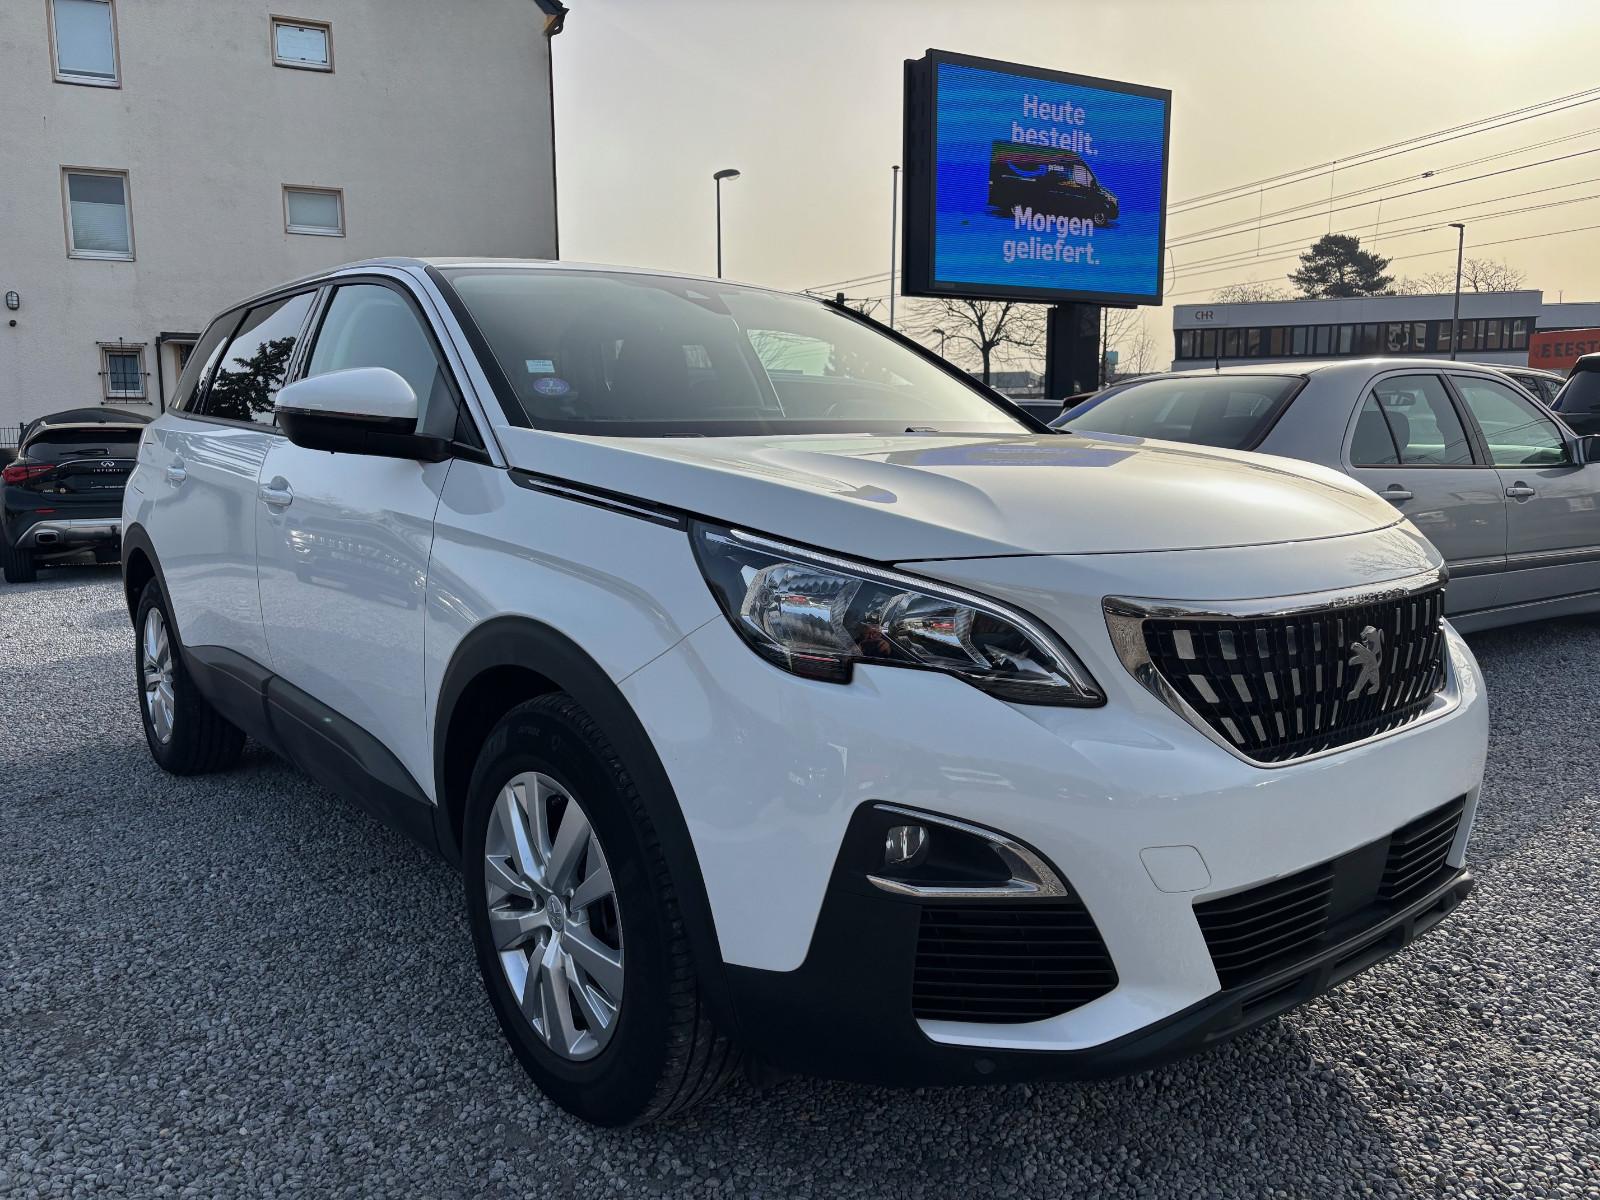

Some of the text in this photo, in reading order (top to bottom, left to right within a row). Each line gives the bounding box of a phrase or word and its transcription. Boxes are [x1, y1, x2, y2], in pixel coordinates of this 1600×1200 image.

[1023, 93, 1086, 125] Heute
[1011, 120, 1098, 156] bestellt.
[1014, 205, 1094, 238] Morgen
[1003, 236, 1100, 265] geliefert.
